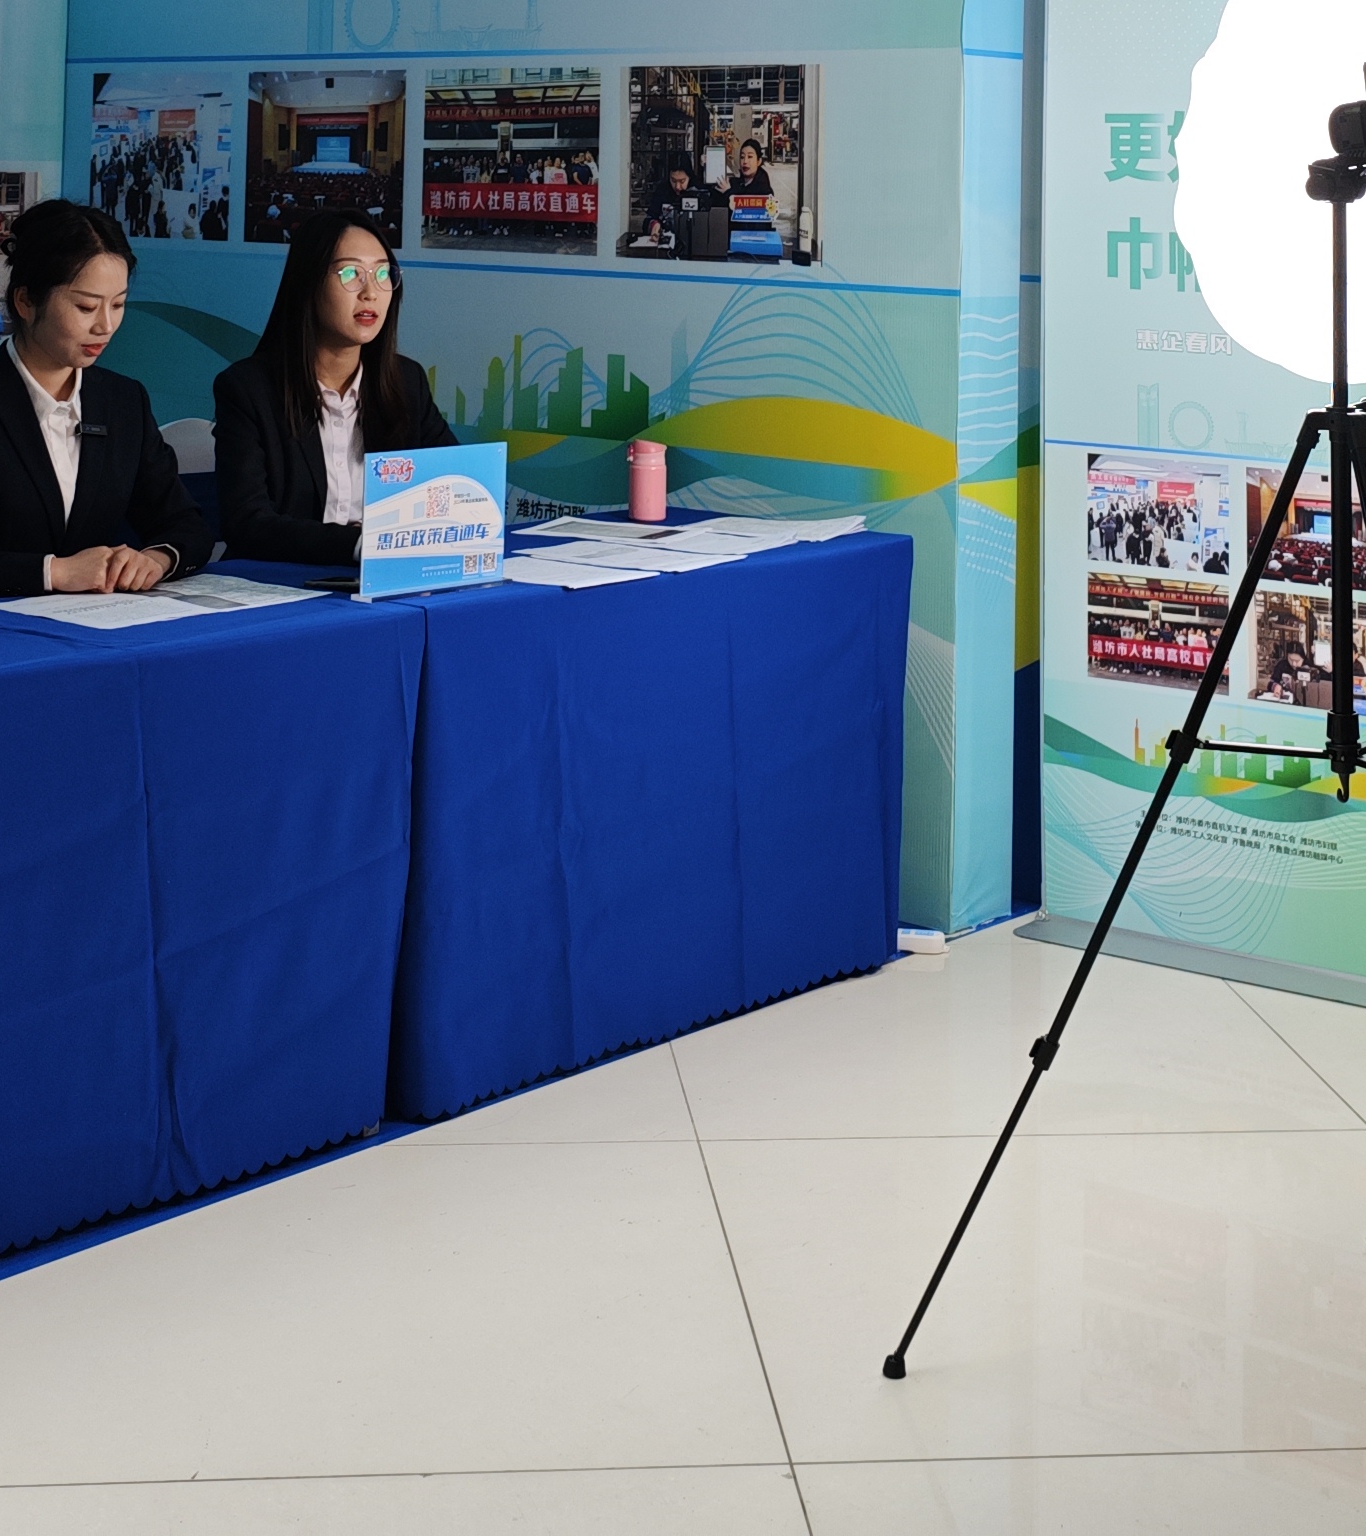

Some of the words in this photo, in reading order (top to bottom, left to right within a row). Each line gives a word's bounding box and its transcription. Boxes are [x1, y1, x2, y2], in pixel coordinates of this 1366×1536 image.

[377, 523, 491, 551] 惠企政策直通车
